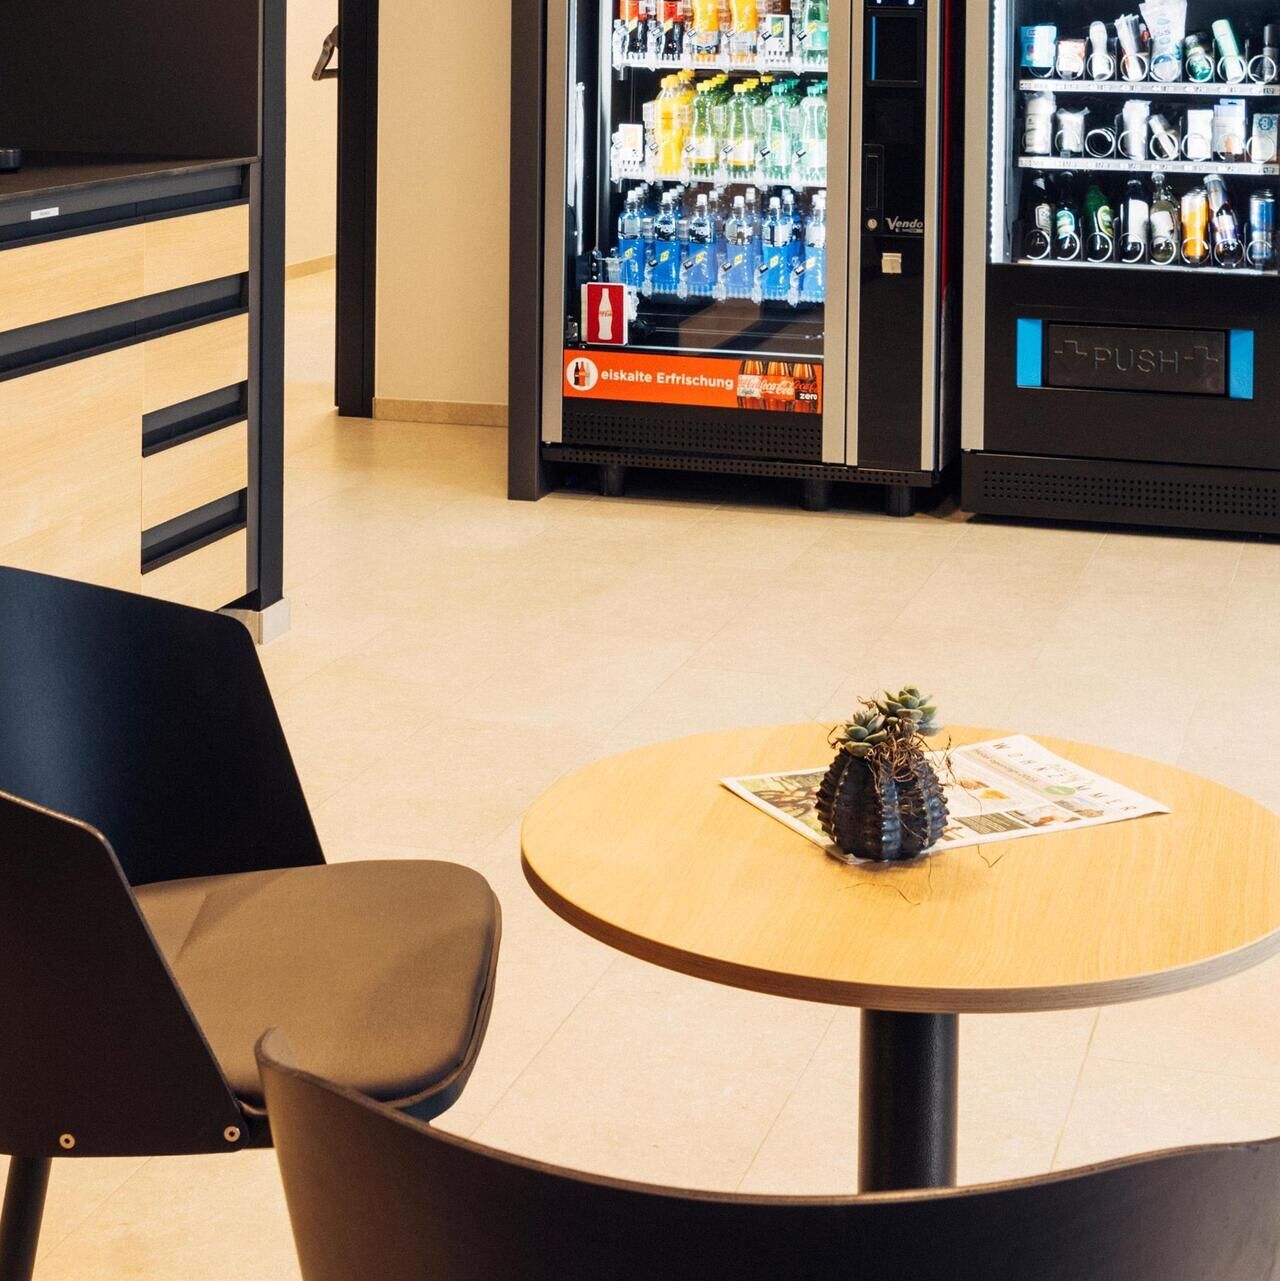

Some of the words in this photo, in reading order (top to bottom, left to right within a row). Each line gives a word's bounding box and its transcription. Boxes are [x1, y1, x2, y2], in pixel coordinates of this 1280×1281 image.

[885, 216, 924, 230] Vendo
[1093, 346, 1179, 373] PUSH
[601, 370, 652, 383] eiskalte
[656, 373, 734, 390] Erfrischung
